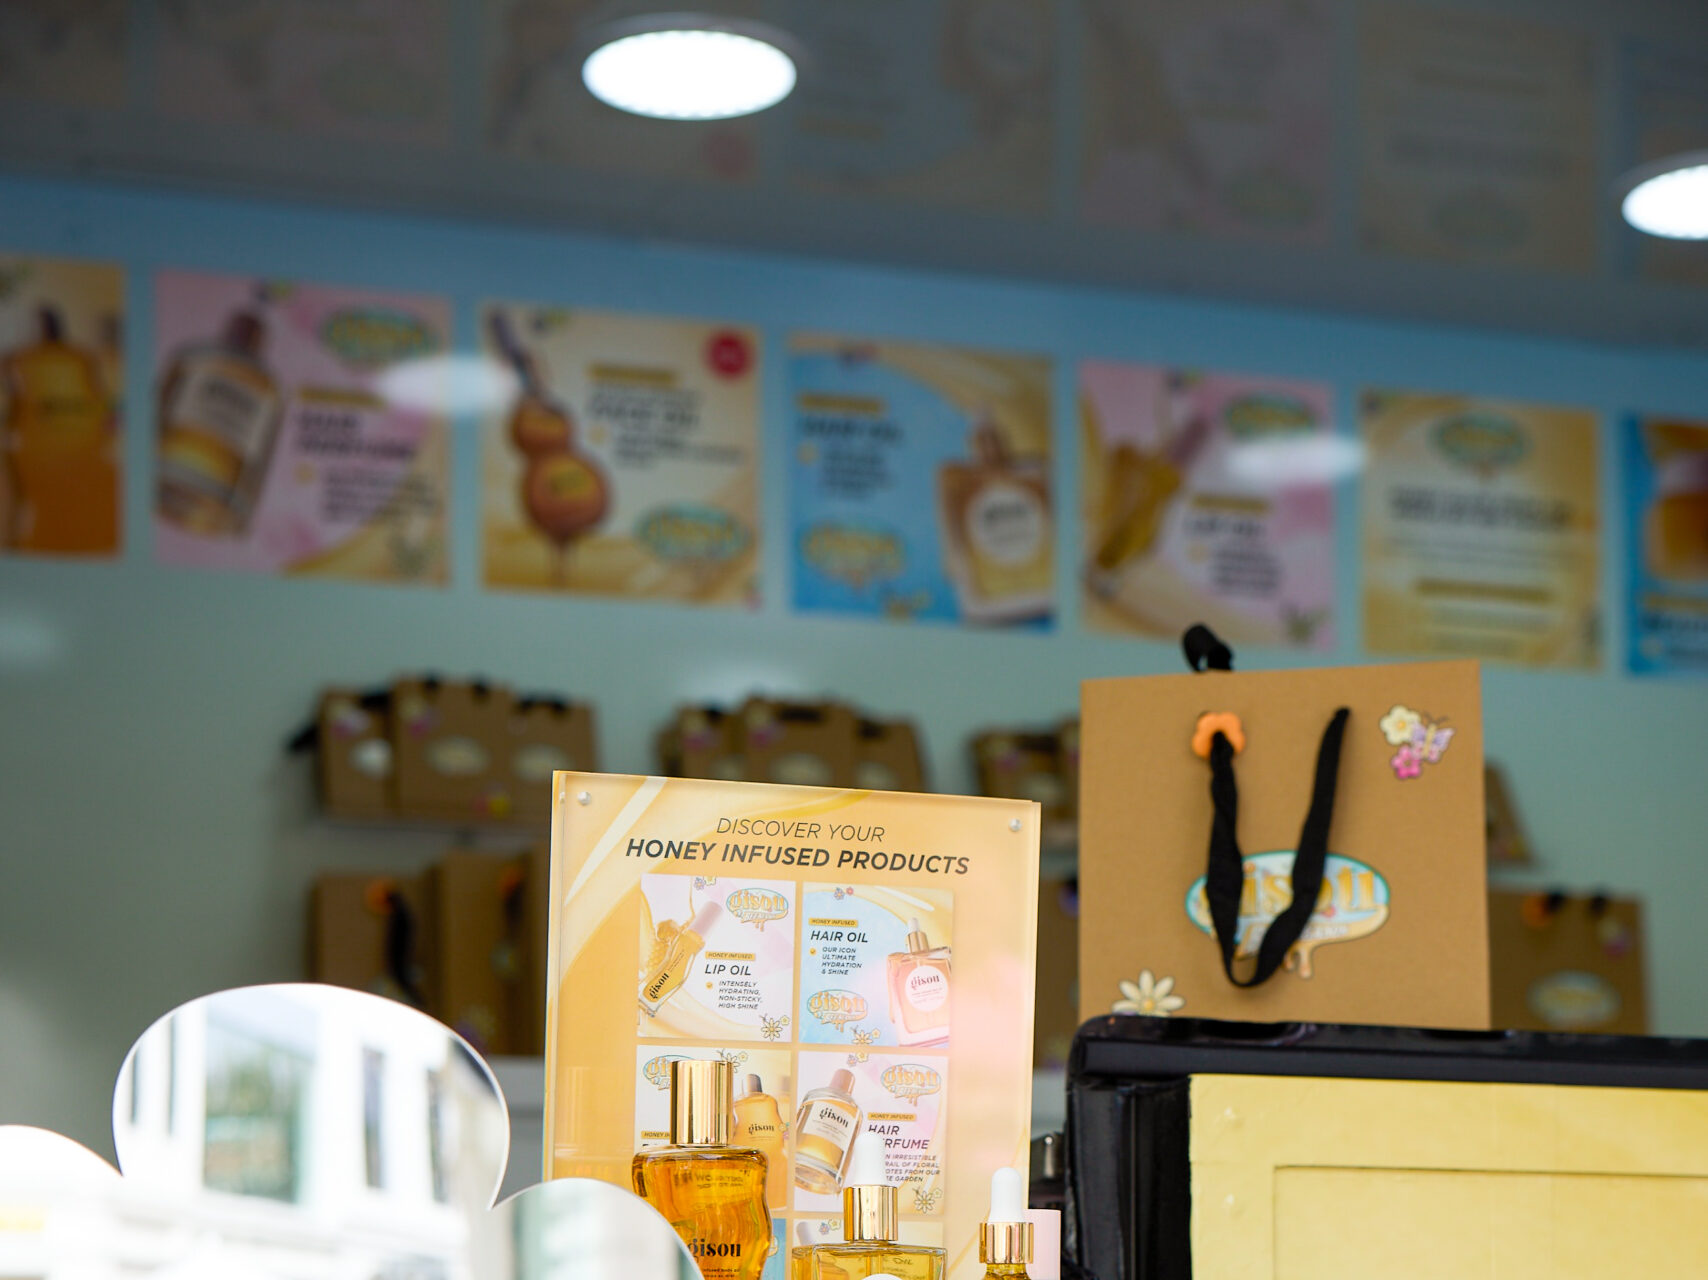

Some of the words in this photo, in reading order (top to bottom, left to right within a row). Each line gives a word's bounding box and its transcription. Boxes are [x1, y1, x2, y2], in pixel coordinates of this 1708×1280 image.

[716, 817, 821, 839] DISCOVER
[828, 823, 886, 842] YOUR
[625, 838, 717, 861] HONEY
[721, 843, 830, 867] INFUSED
[837, 849, 970, 875] PRODUCTS
[810, 930, 843, 941] HAIR
[847, 932, 868, 943] OIL
[705, 964, 726, 974] LIP
[730, 965, 751, 975] OIL
[869, 1124, 900, 1135] HAIR
[884, 1138, 930, 1149] RFUME
